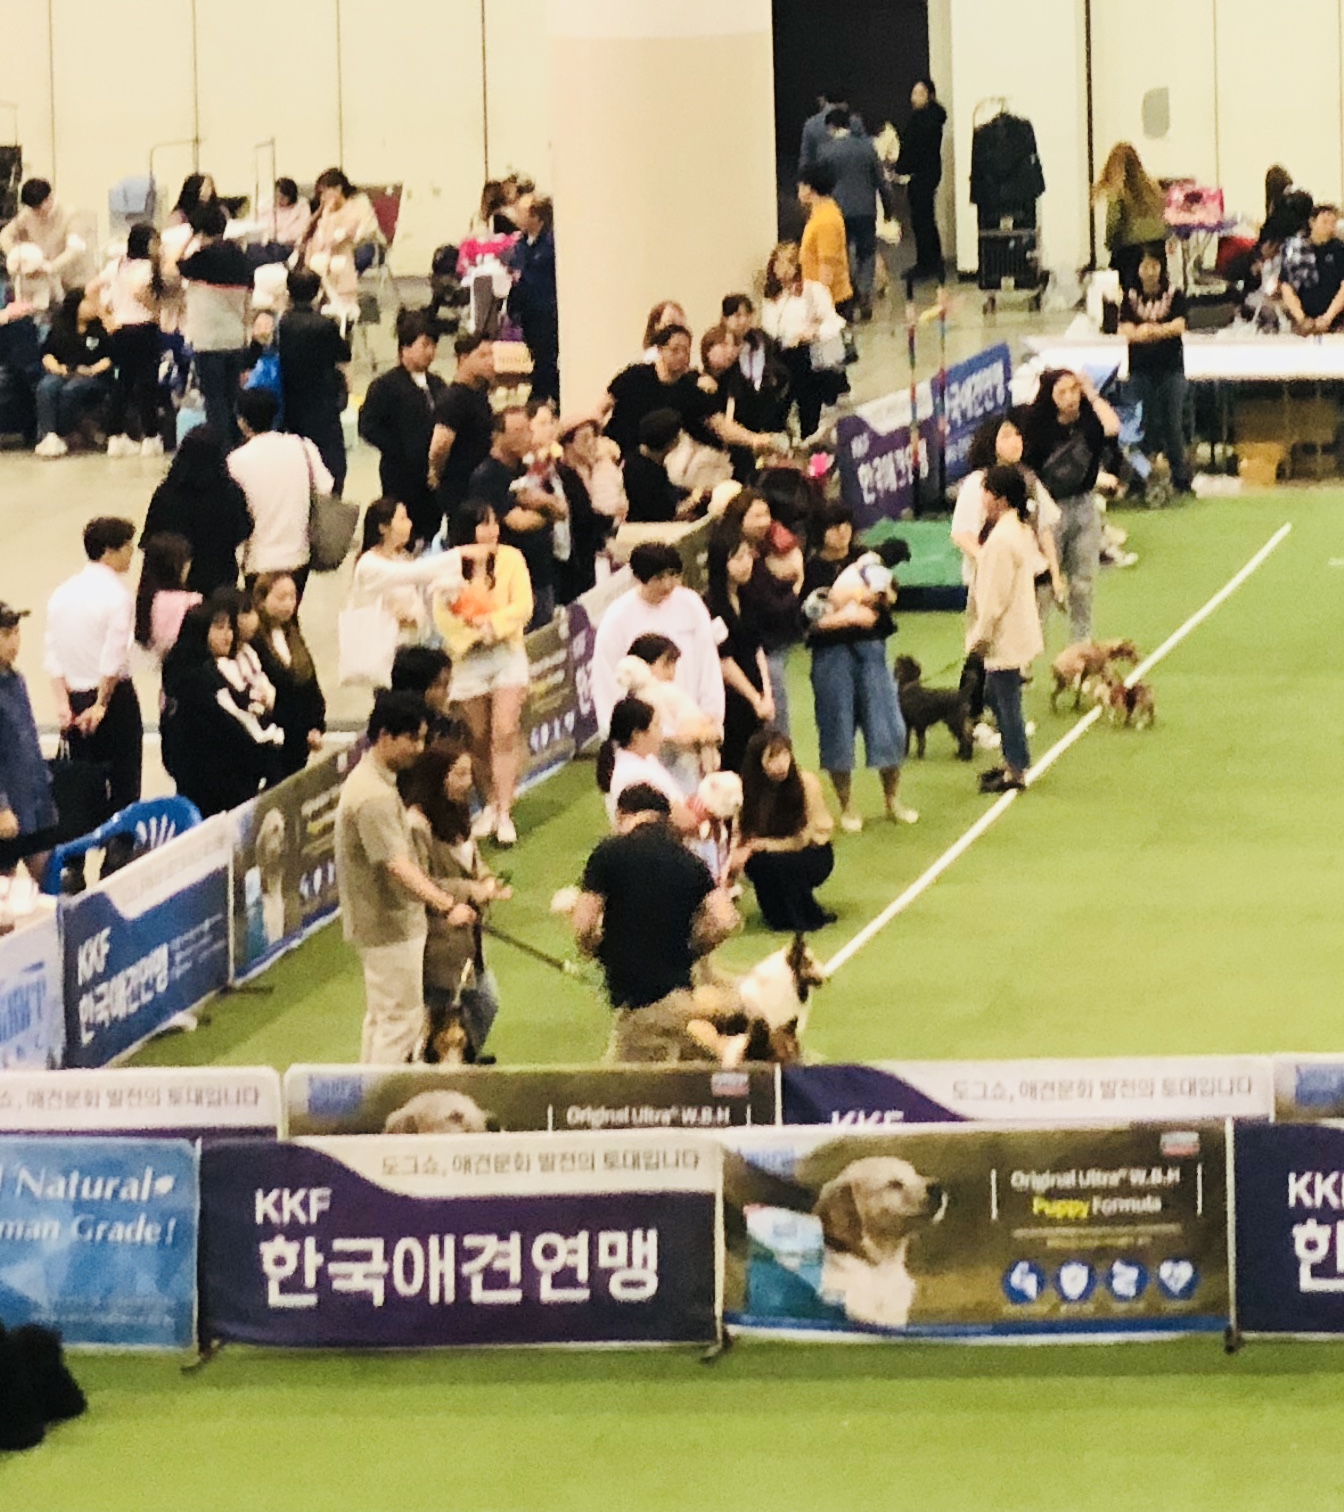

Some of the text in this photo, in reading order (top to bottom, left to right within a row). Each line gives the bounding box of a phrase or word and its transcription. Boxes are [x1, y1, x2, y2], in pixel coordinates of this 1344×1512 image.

[15, 1163, 154, 1203] Natural
[254, 1187, 332, 1227] KKF
[257, 1228, 660, 1309] 한국애견연맹
